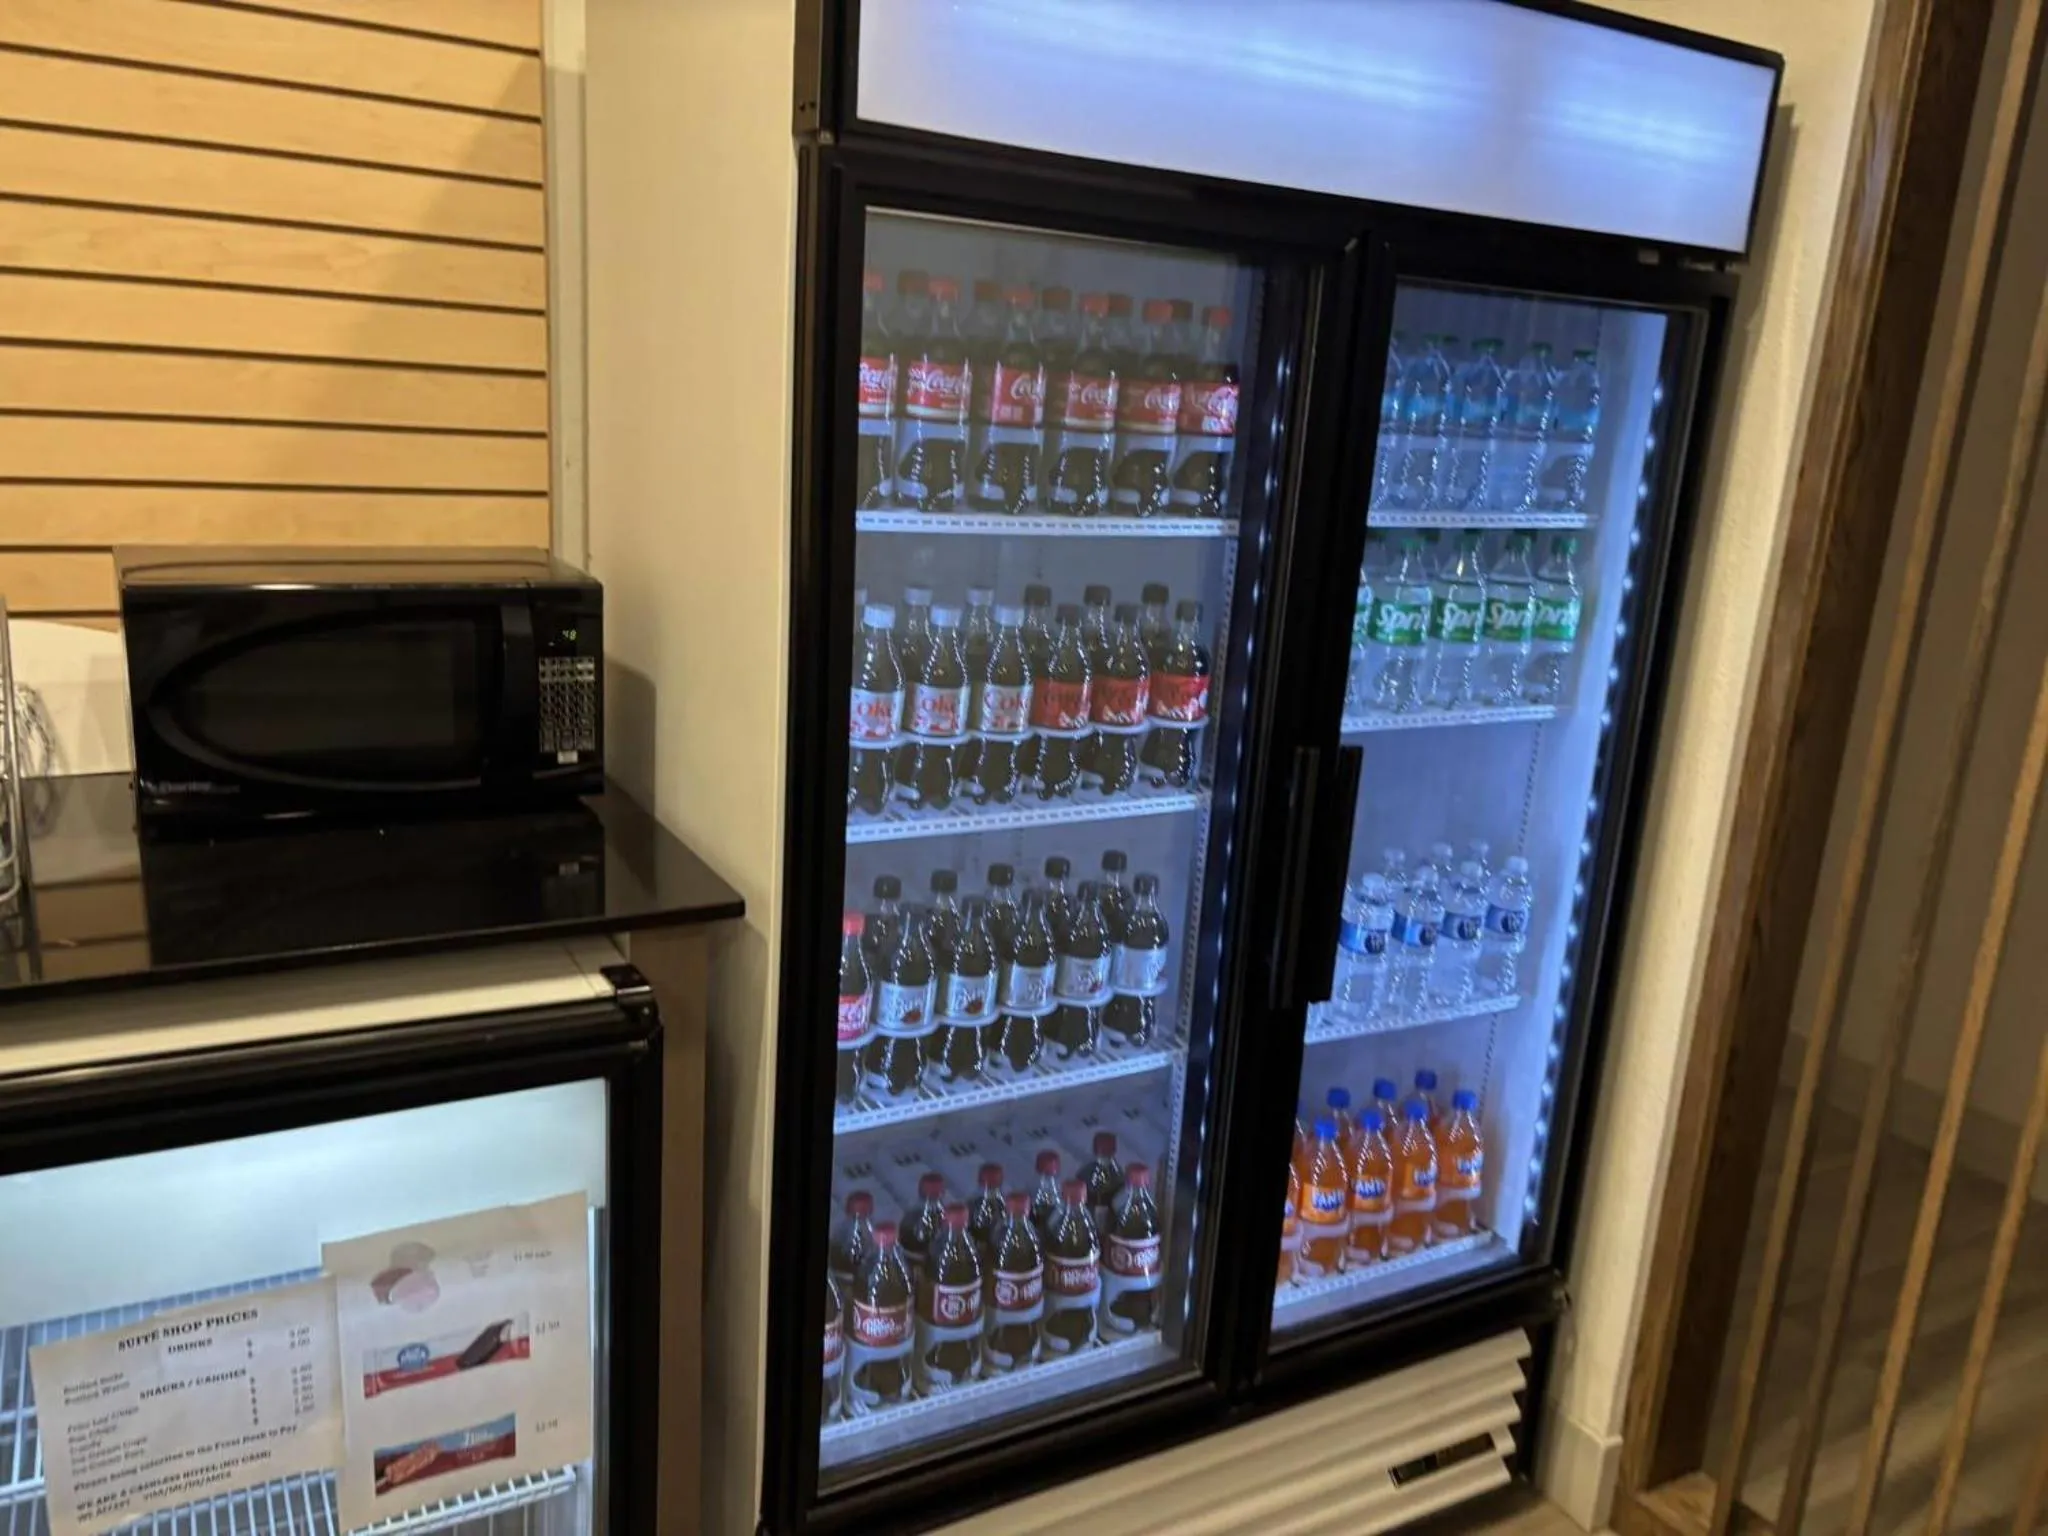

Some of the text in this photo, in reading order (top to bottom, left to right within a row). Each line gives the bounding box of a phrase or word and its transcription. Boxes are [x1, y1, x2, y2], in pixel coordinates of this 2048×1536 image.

[117, 1309, 258, 1352] SUITE SHOP PRICES
[167, 1338, 213, 1354] DRINKS
[139, 1382, 186, 1401] SNACKS
